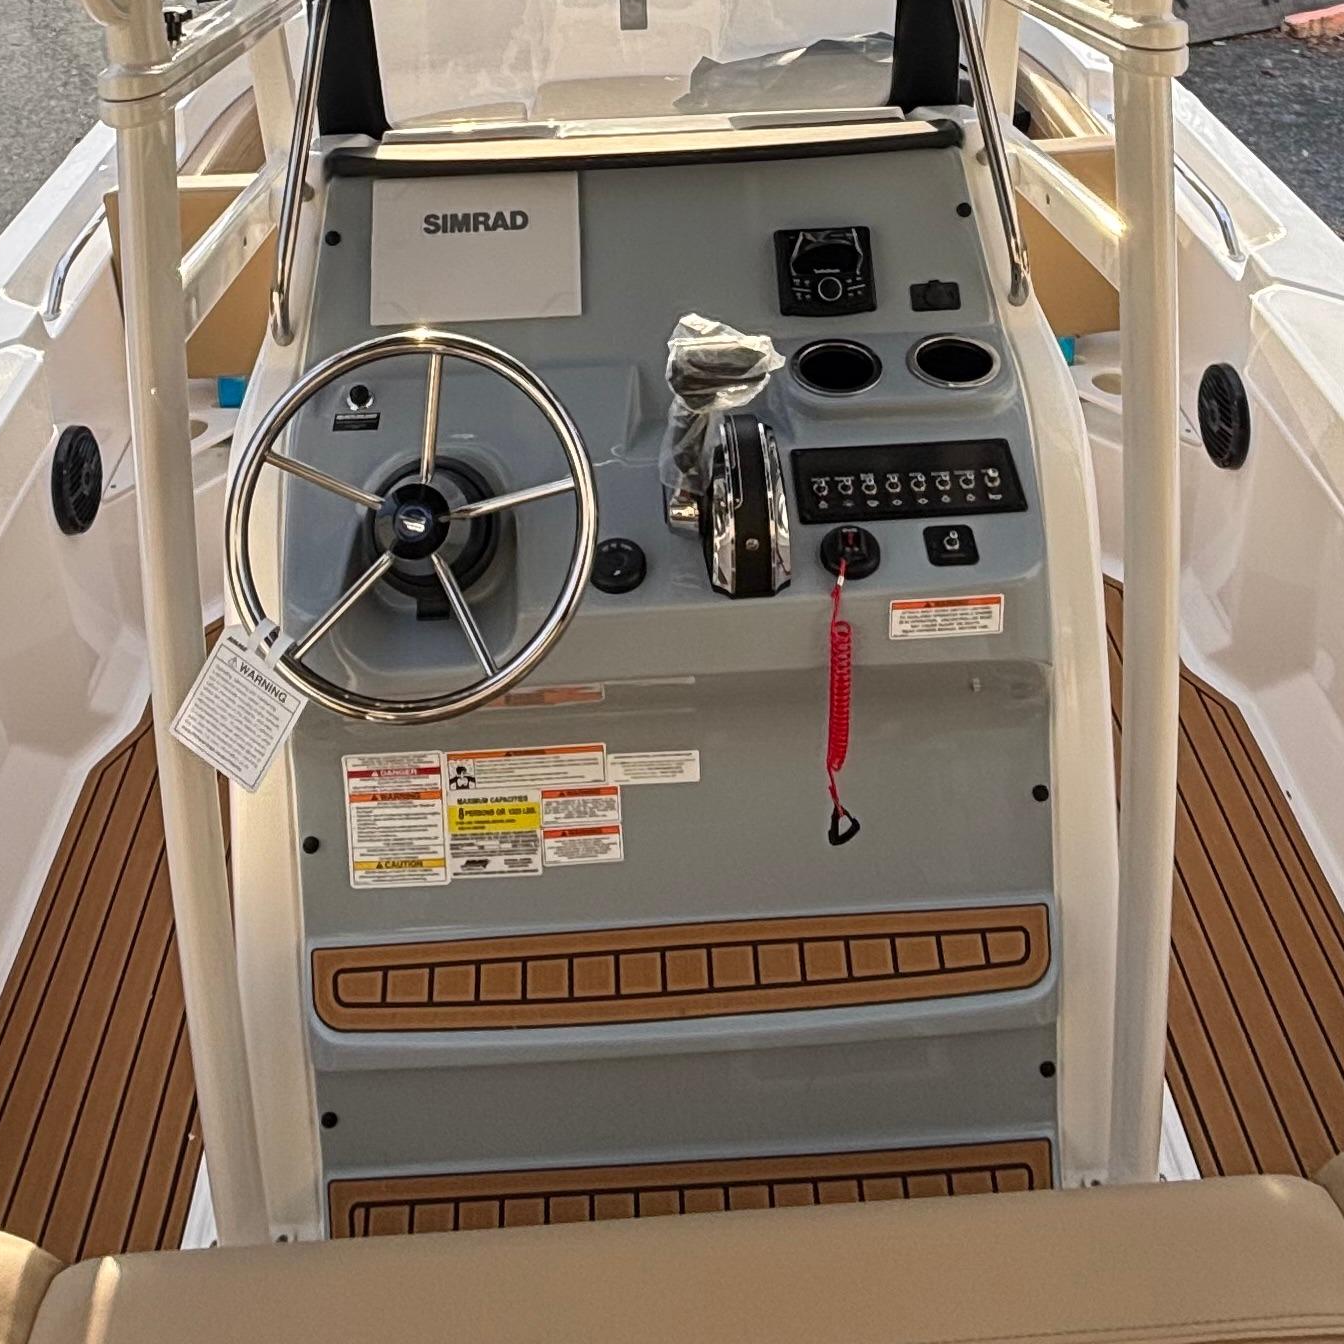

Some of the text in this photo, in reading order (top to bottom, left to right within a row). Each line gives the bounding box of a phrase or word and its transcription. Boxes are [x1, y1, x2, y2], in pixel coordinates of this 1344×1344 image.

[423, 210, 529, 235] SIMRAD
[239, 661, 288, 704] WARNING
[384, 860, 423, 869] CAUTION
